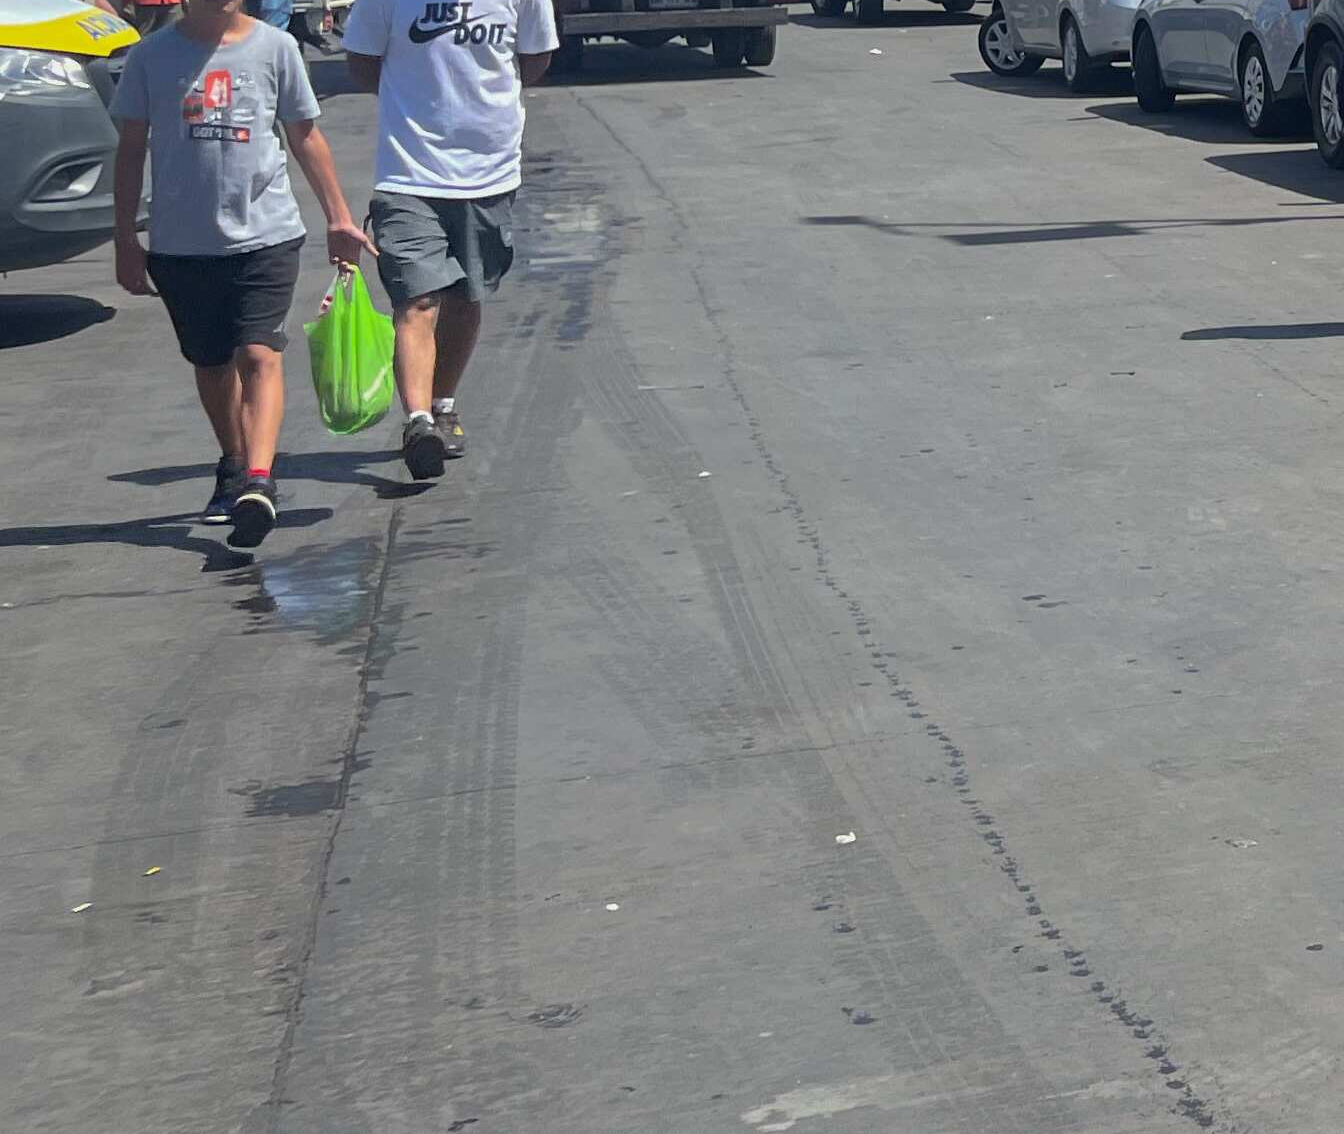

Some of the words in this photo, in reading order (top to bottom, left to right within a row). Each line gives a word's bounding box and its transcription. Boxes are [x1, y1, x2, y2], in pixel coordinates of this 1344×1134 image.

[420, 2, 473, 24] JUST
[453, 24, 488, 45] DO
[488, 23, 508, 45] IT
